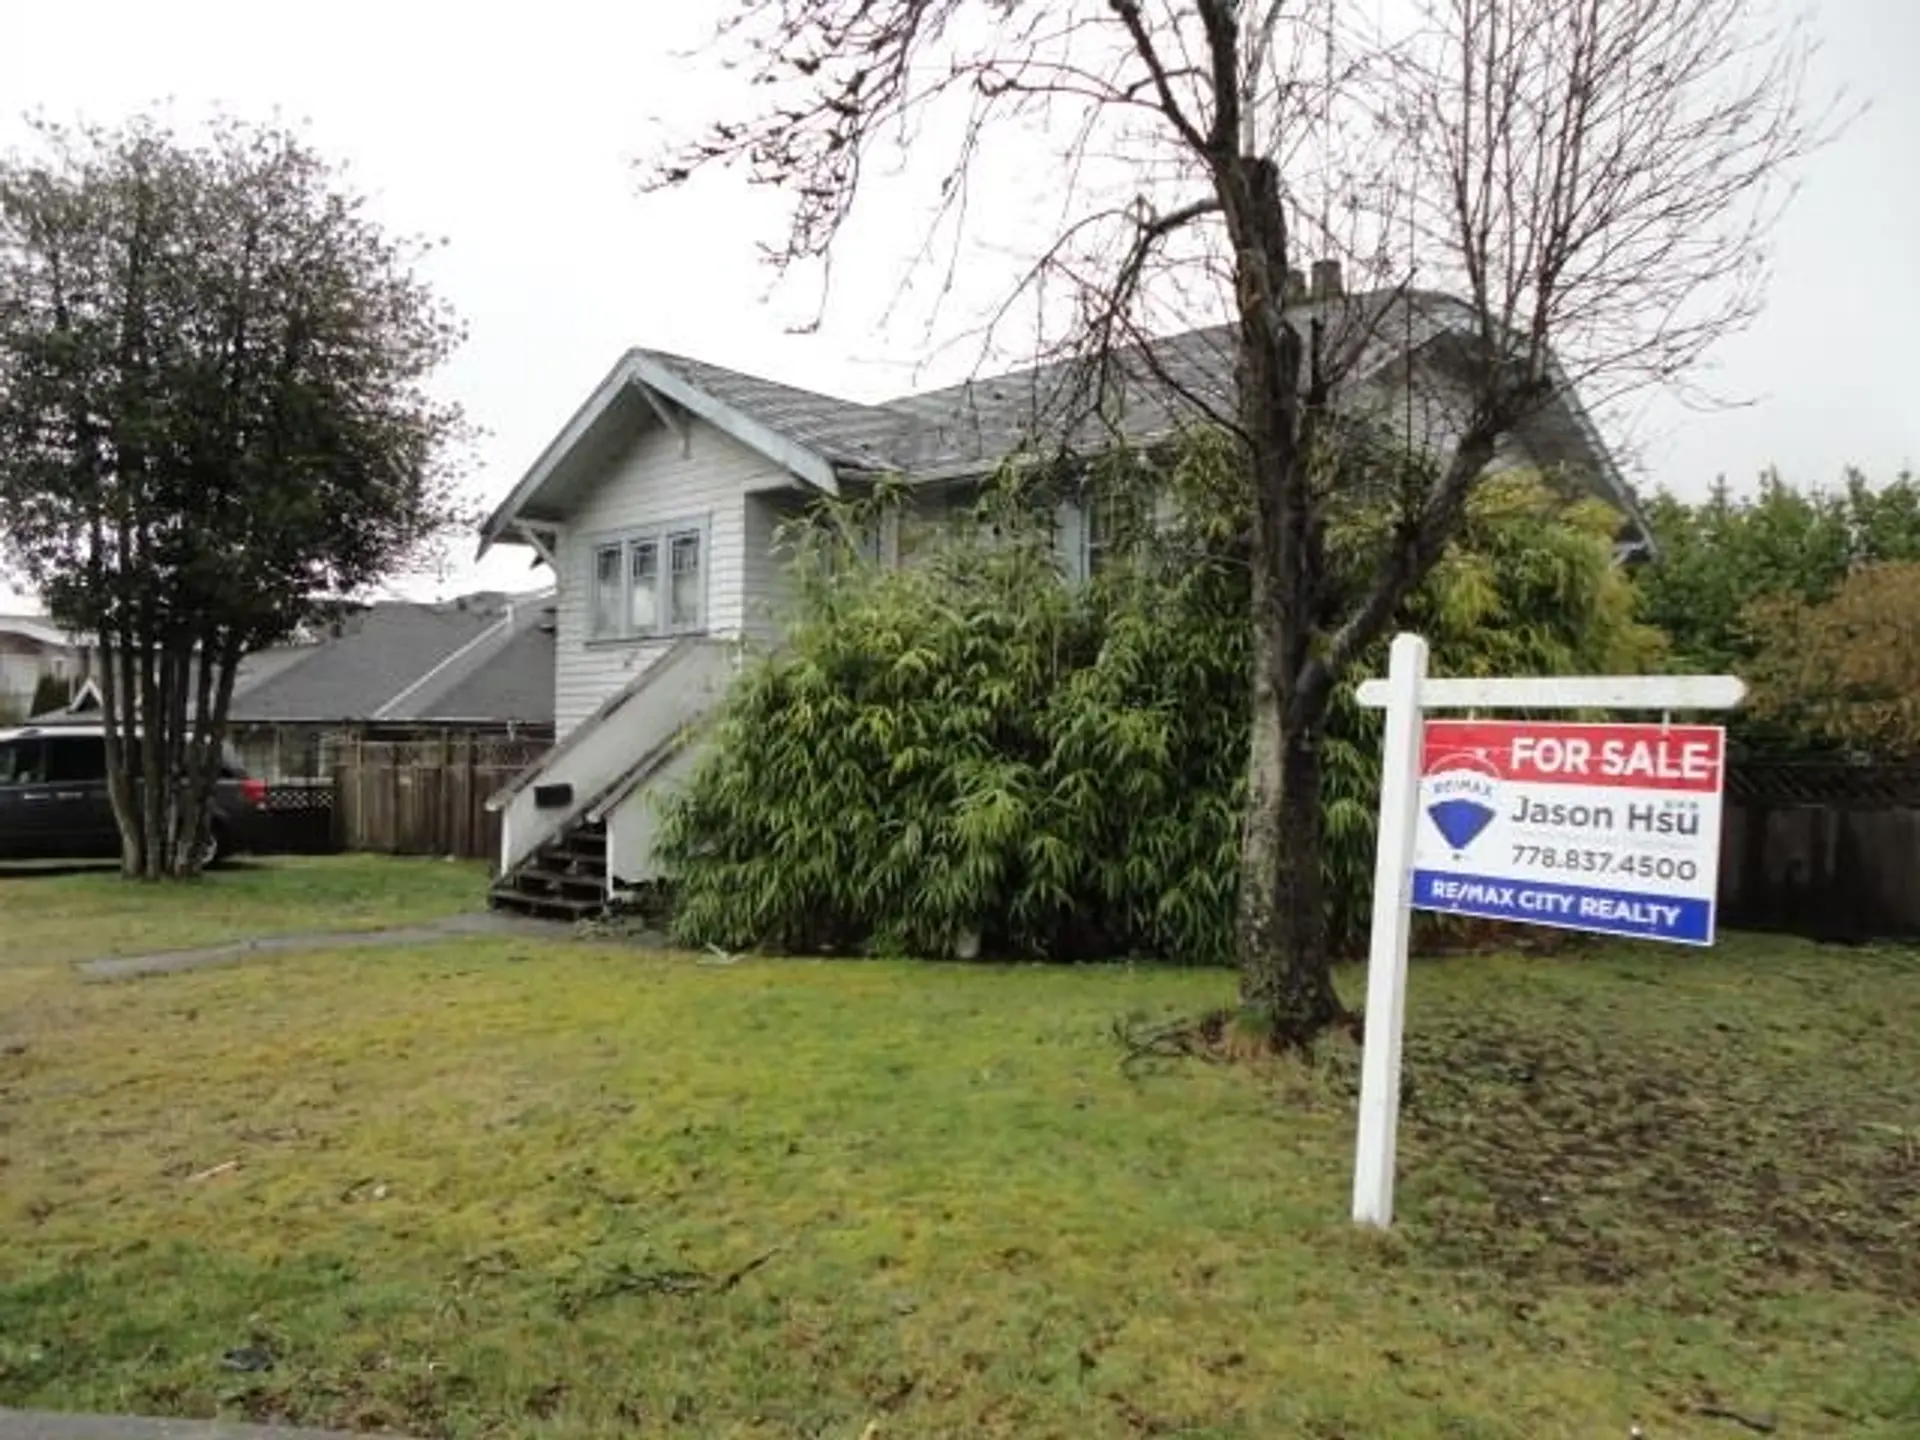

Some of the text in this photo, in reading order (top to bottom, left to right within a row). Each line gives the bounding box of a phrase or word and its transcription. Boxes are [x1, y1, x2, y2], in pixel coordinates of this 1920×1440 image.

[1510, 737, 1711, 780] FOR SALE
[1511, 795, 1699, 835] Jason Hsu
[1512, 844, 1697, 881] 778.837.4500
[1431, 880, 1682, 928] RE/MAX CITY REALTY
